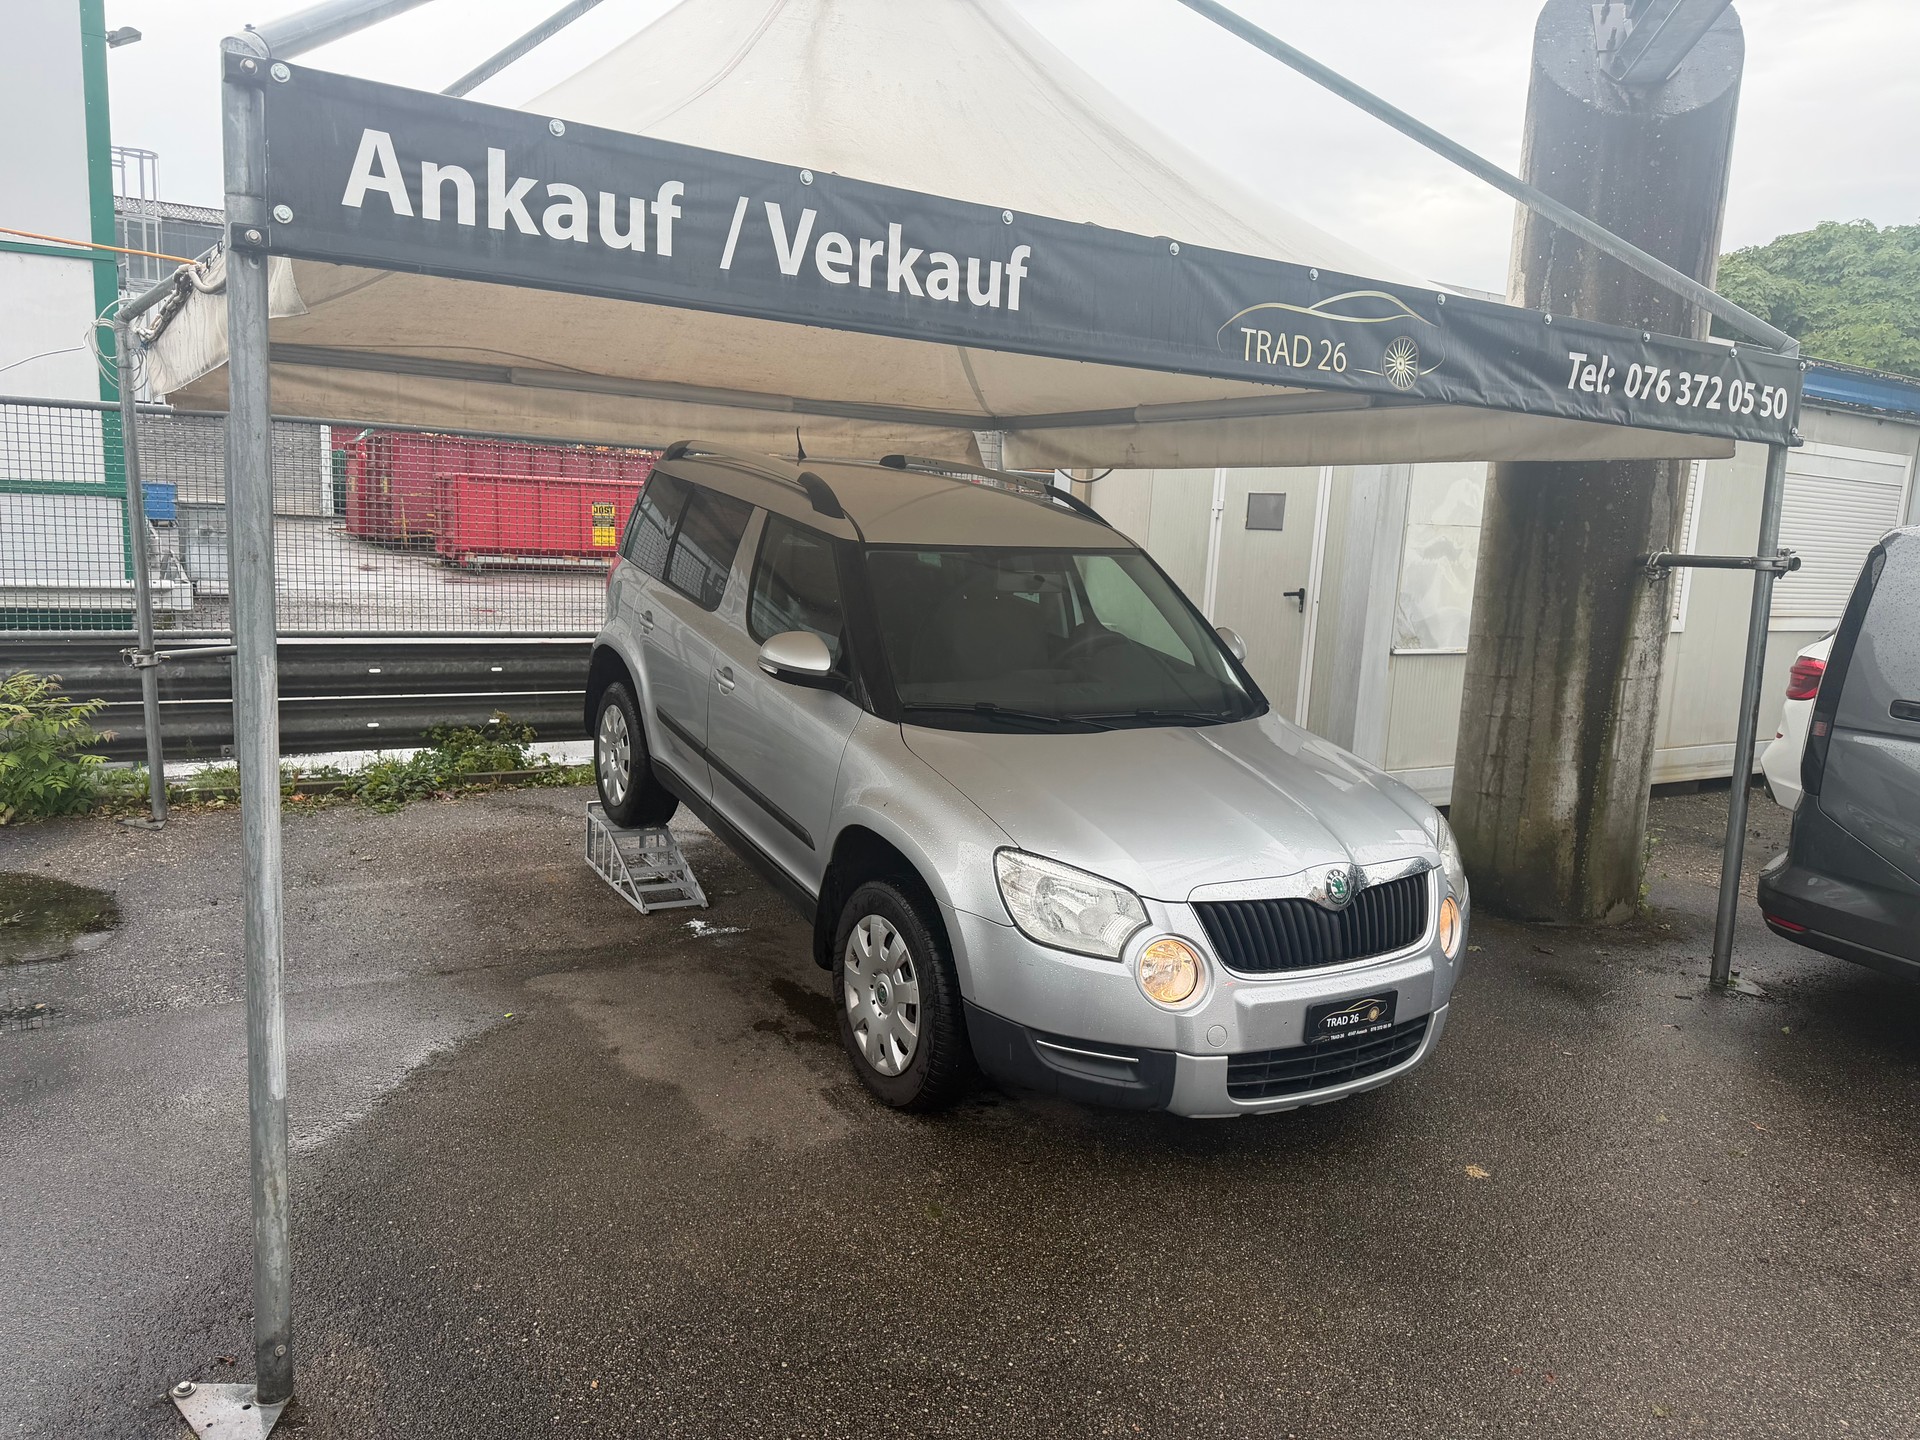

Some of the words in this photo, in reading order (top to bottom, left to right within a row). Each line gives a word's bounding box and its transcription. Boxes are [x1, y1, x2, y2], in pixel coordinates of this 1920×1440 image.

[341, 128, 685, 257] Ankauf
[719, 196, 749, 270] /
[764, 201, 1032, 311] Verkauf
[1240, 327, 1312, 368] TRAD
[1317, 339, 1347, 373] 26
[1567, 352, 1616, 395] Tel:
[1623, 363, 1671, 403] 076
[1675, 371, 1724, 410] 372
[1728, 379, 1756, 415] 05
[1759, 385, 1788, 420] 50
[1326, 1015, 1349, 1028] TRAD
[1349, 1013, 1360, 1024] 26
